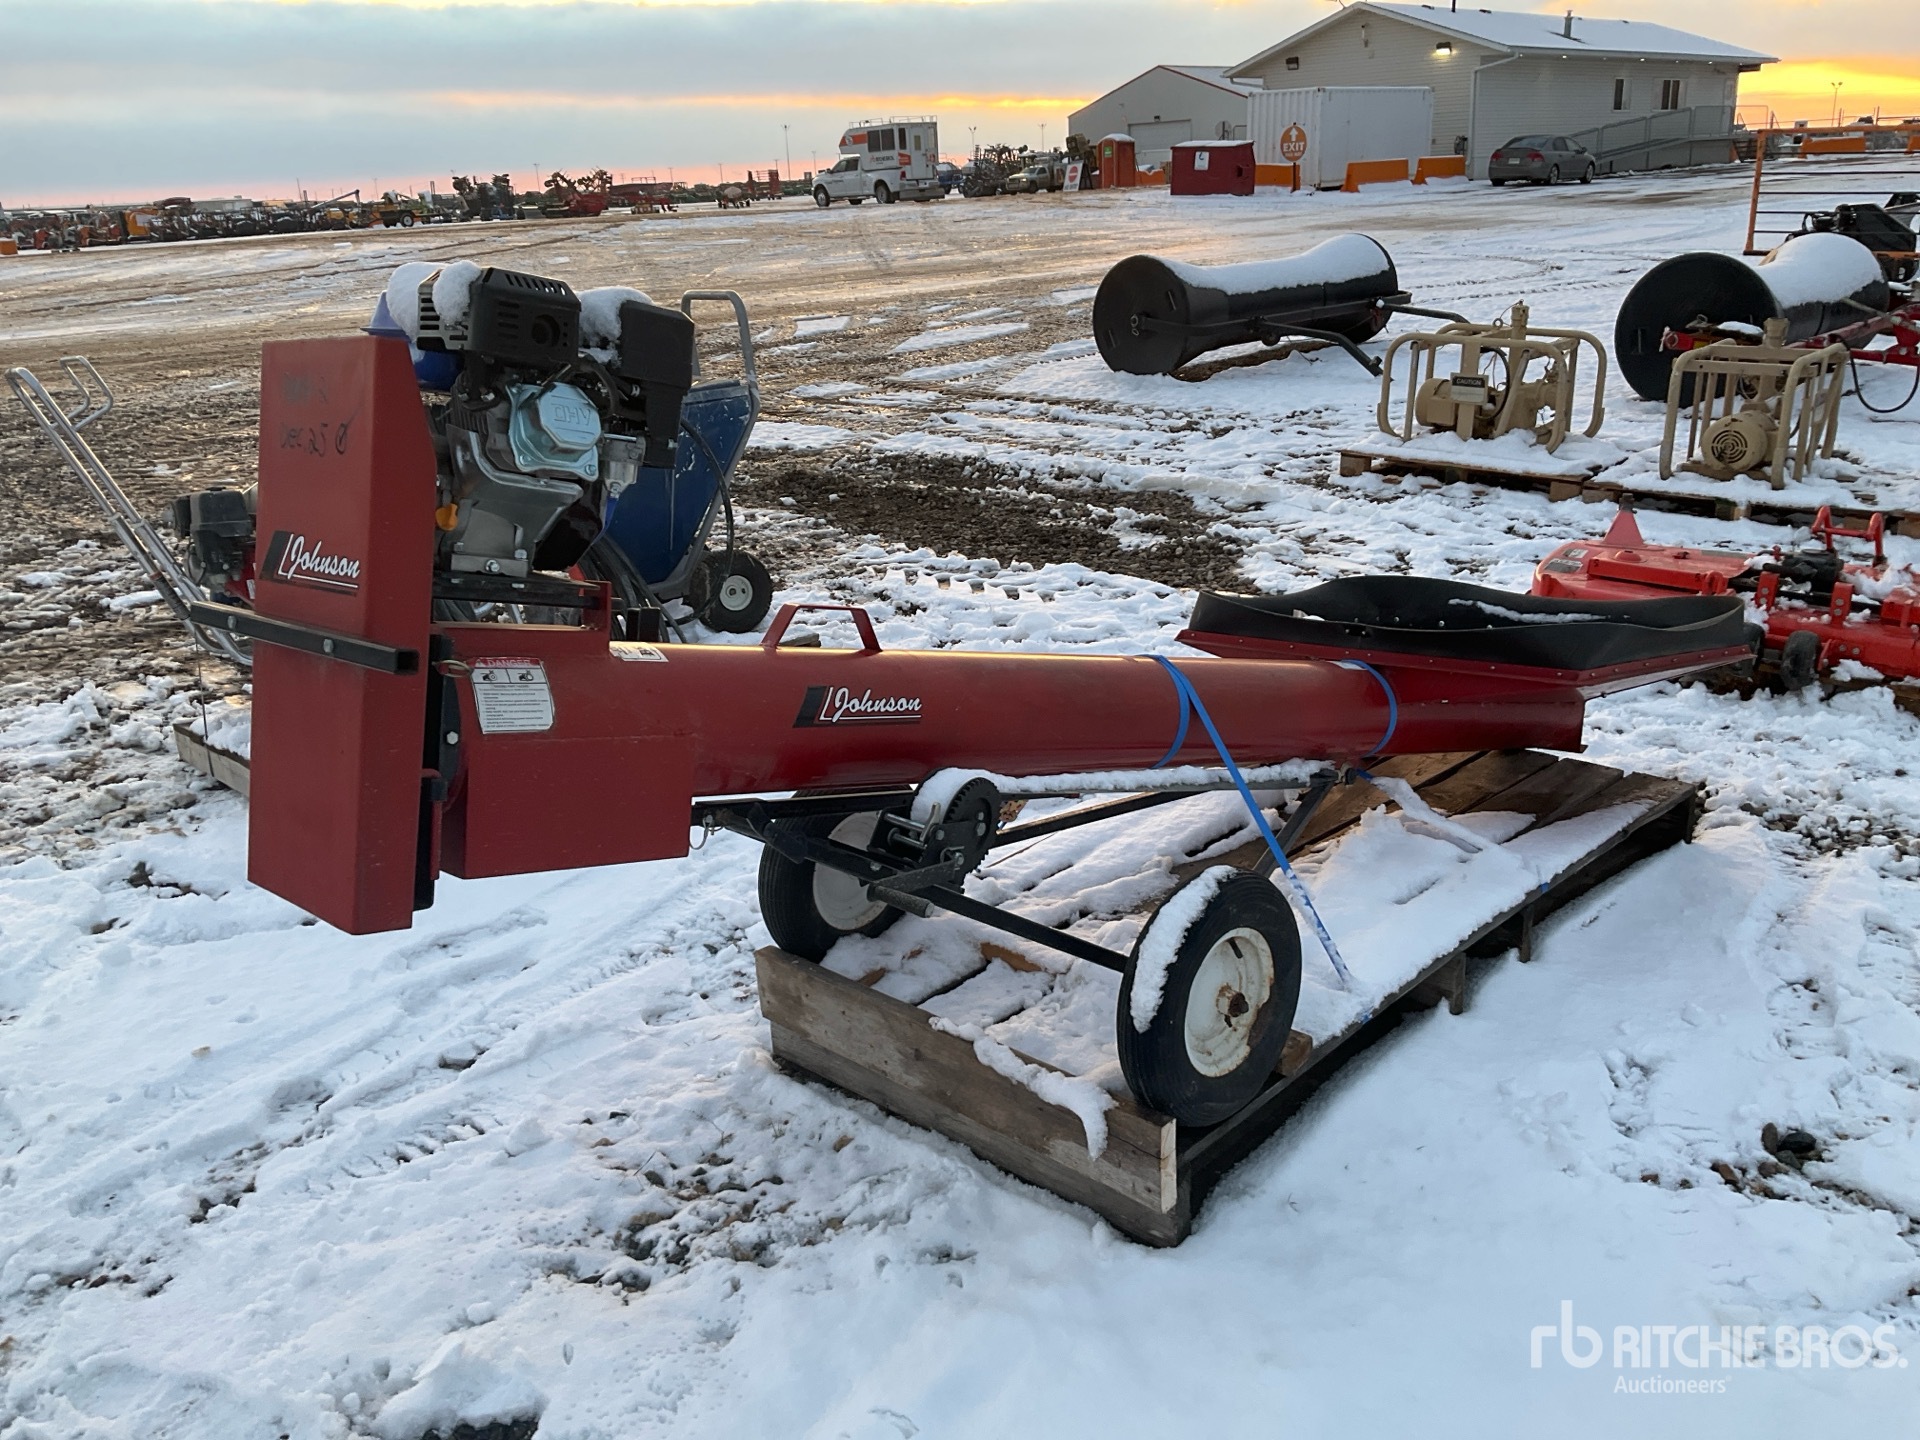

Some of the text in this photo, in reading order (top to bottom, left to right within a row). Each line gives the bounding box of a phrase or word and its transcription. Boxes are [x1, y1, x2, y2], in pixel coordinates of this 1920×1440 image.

[1283, 142, 1305, 152] EXIT
[551, 403, 592, 426] OHV
[288, 536, 360, 579] Johnson
[487, 659, 531, 668] DANGER
[832, 687, 922, 722] Johnson
